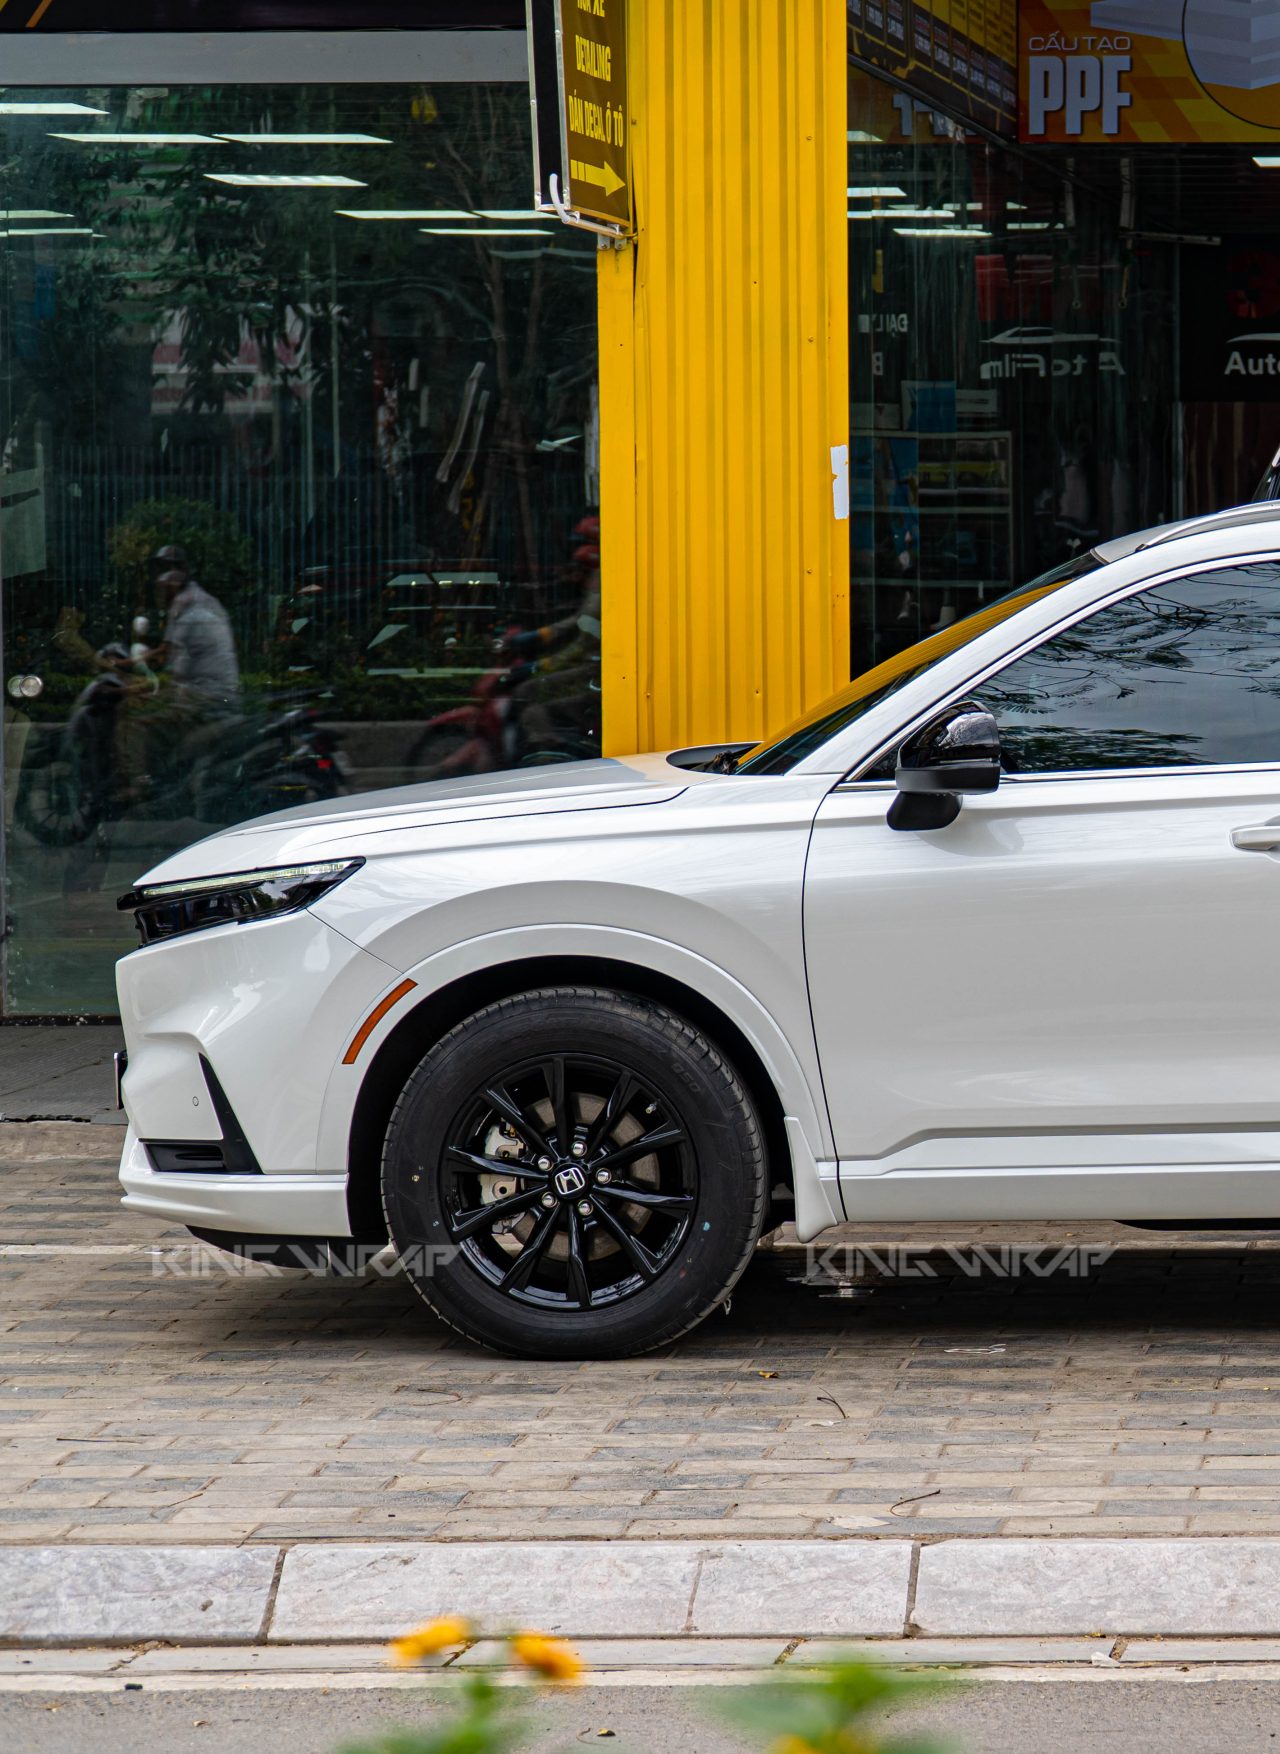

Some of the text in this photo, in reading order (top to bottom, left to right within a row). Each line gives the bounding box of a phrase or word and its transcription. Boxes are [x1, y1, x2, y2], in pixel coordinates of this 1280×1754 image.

[575, 34, 611, 82] DETAILING
[1028, 30, 1132, 54] CẤU TẠO
[568, 89, 624, 148] DÁN DECAL Ô TÔ
[1028, 55, 1132, 135] PPF
